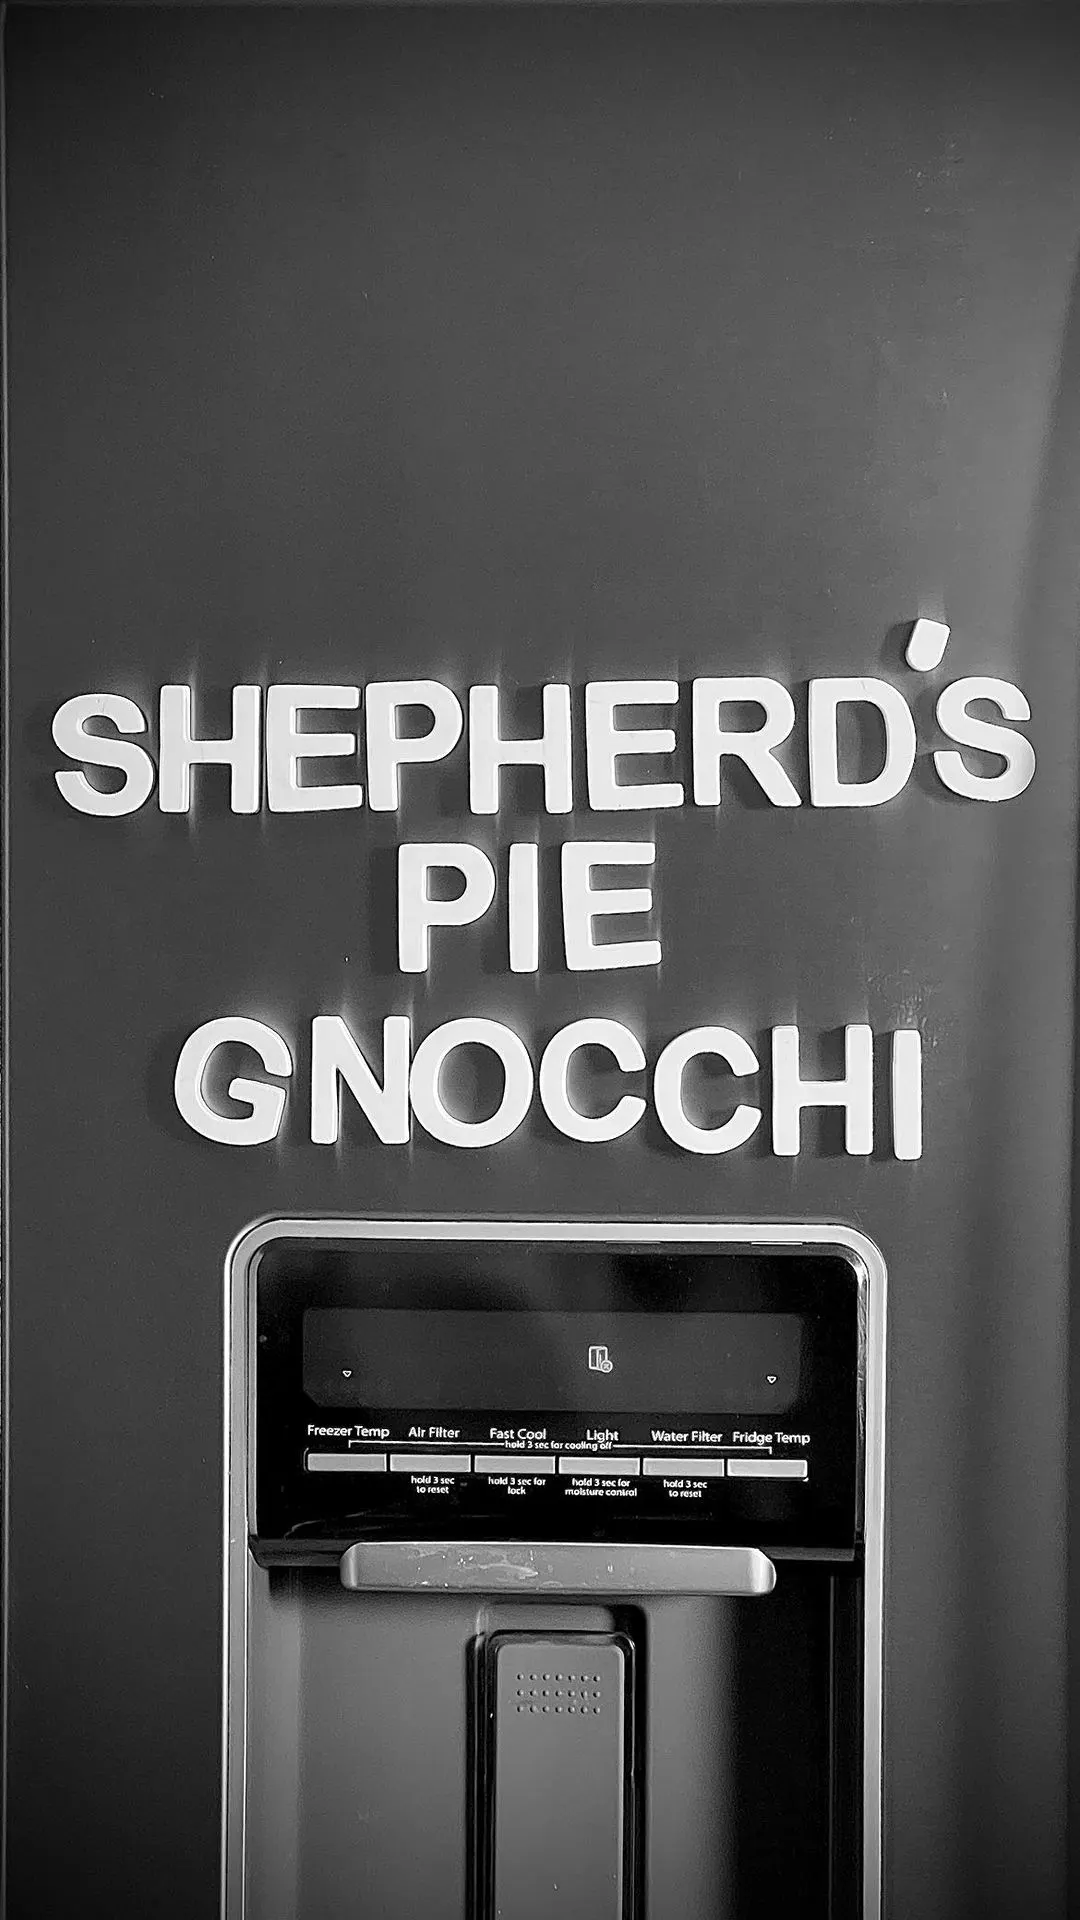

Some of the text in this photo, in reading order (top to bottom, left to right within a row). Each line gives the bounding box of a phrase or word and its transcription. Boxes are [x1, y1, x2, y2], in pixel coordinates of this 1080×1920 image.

[52, 618, 1036, 816] SHEPHERD'S
[398, 843, 662, 972] PIE
[174, 1015, 922, 1161] GNOCCHI
[307, 1425, 390, 1438] Freezer Temp
[408, 1427, 460, 1438] Air Filter
[490, 1428, 546, 1439] Fast Cool
[587, 1429, 618, 1443] Light
[652, 1431, 723, 1442] Water Filter
[733, 1432, 810, 1445] Fridge Temp
[505, 1440, 525, 1449] hold
[528, 1441, 533, 1449] 3
[549, 1441, 563, 1449] for
[565, 1442, 598, 1450] cooling
[600, 1442, 613, 1450] off
[411, 1476, 431, 1484] hold
[433, 1476, 438, 1484] 3
[488, 1477, 509, 1485] hold
[510, 1477, 515, 1485] 3
[572, 1478, 592, 1487] hold
[594, 1479, 600, 1487] 3
[617, 1479, 631, 1487] for
[663, 1480, 684, 1488] hold
[686, 1480, 691, 1488] 3
[508, 1487, 526, 1495] lock
[565, 1488, 637, 1496] moisture control
